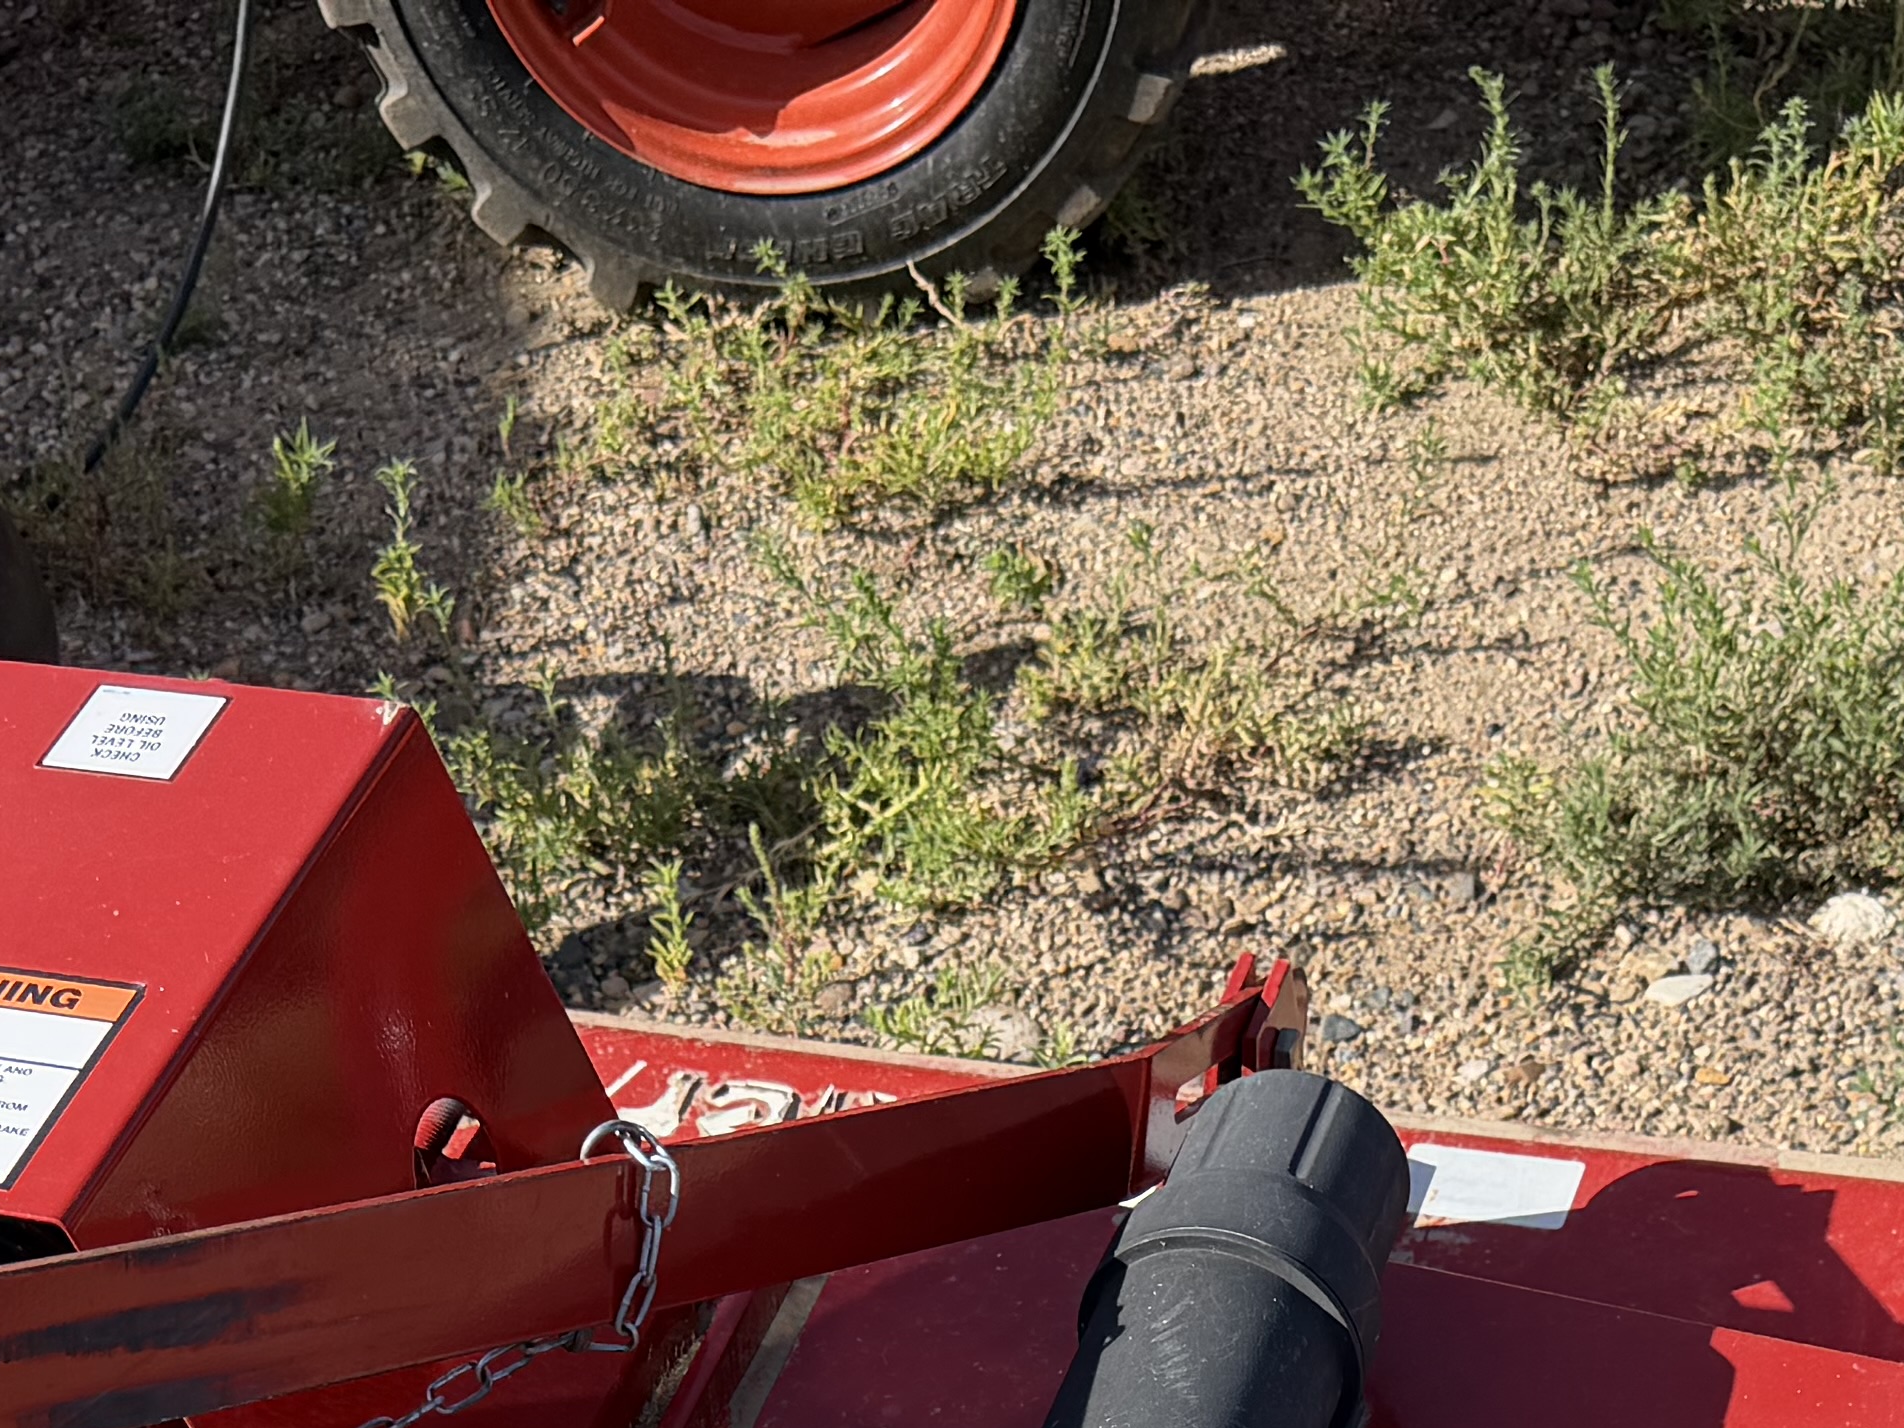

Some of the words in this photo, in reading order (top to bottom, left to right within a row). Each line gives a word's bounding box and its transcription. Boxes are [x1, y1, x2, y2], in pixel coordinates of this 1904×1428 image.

[119, 712, 166, 725] USING
[104, 723, 163, 738] BEFORE
[91, 734, 132, 749] LEVEL
[140, 740, 161, 751] OIL
[90, 747, 141, 762] CHECK
[2, 1064, 33, 1076] AND
